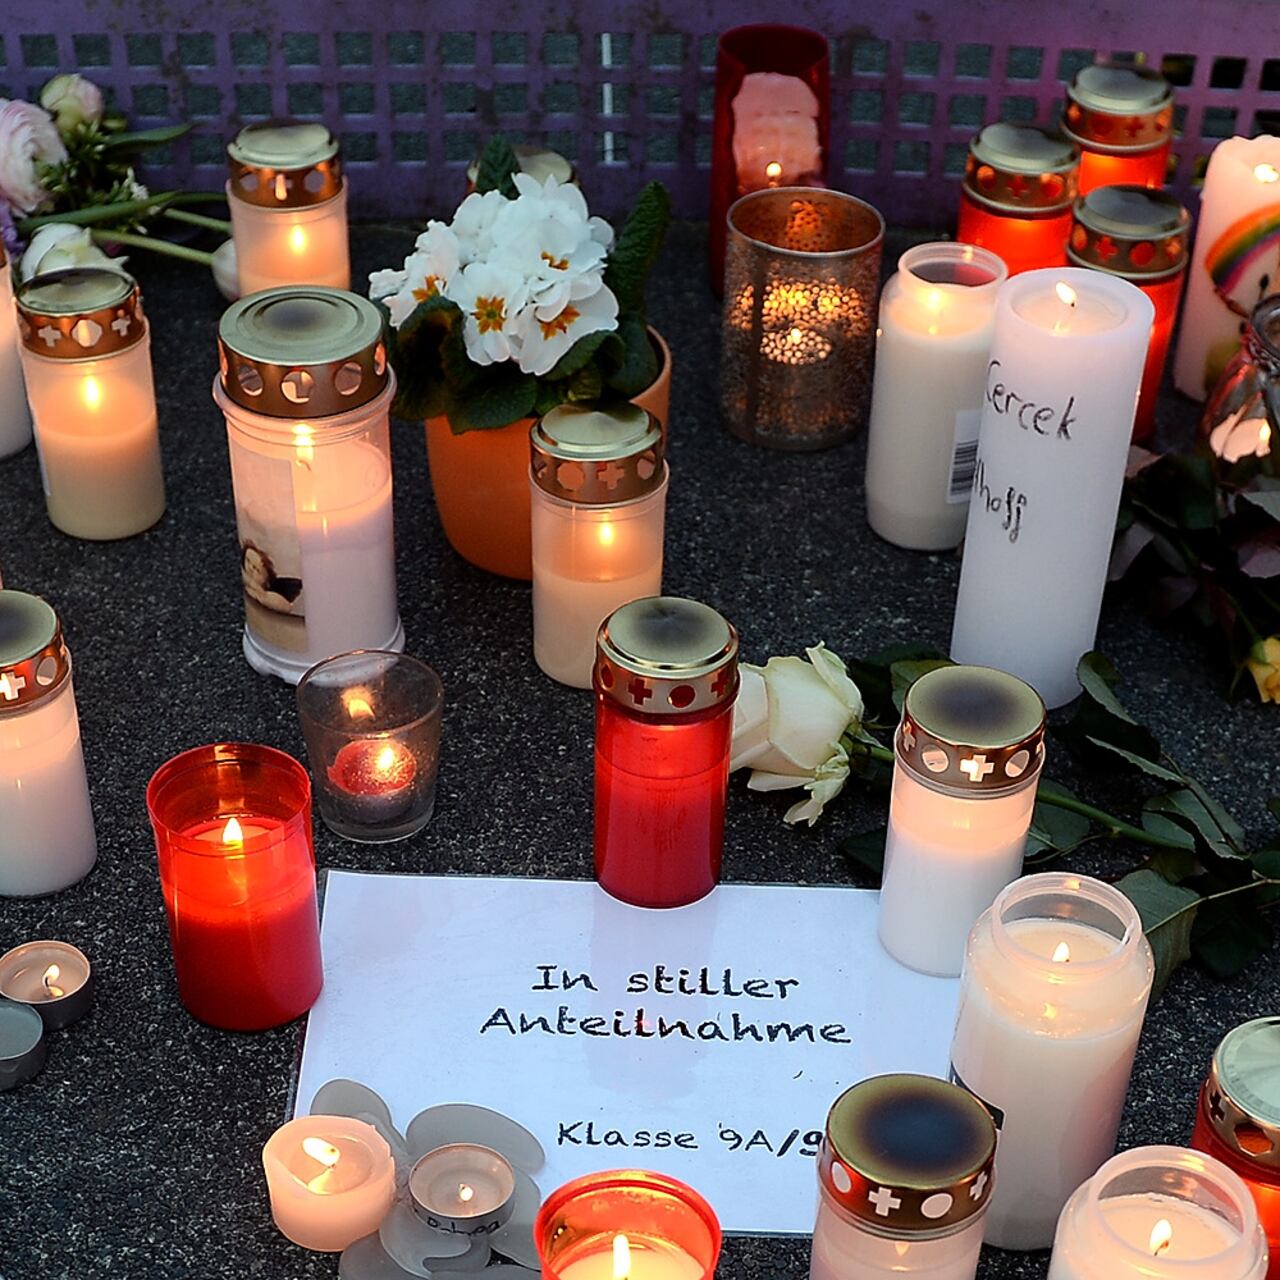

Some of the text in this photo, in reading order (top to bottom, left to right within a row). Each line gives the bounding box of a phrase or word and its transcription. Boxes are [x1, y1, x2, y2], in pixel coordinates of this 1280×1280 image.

[531, 964, 800, 999] In stiller
[480, 1006, 852, 1044] Anteilnahme
[557, 1121, 699, 1149] Klasse
